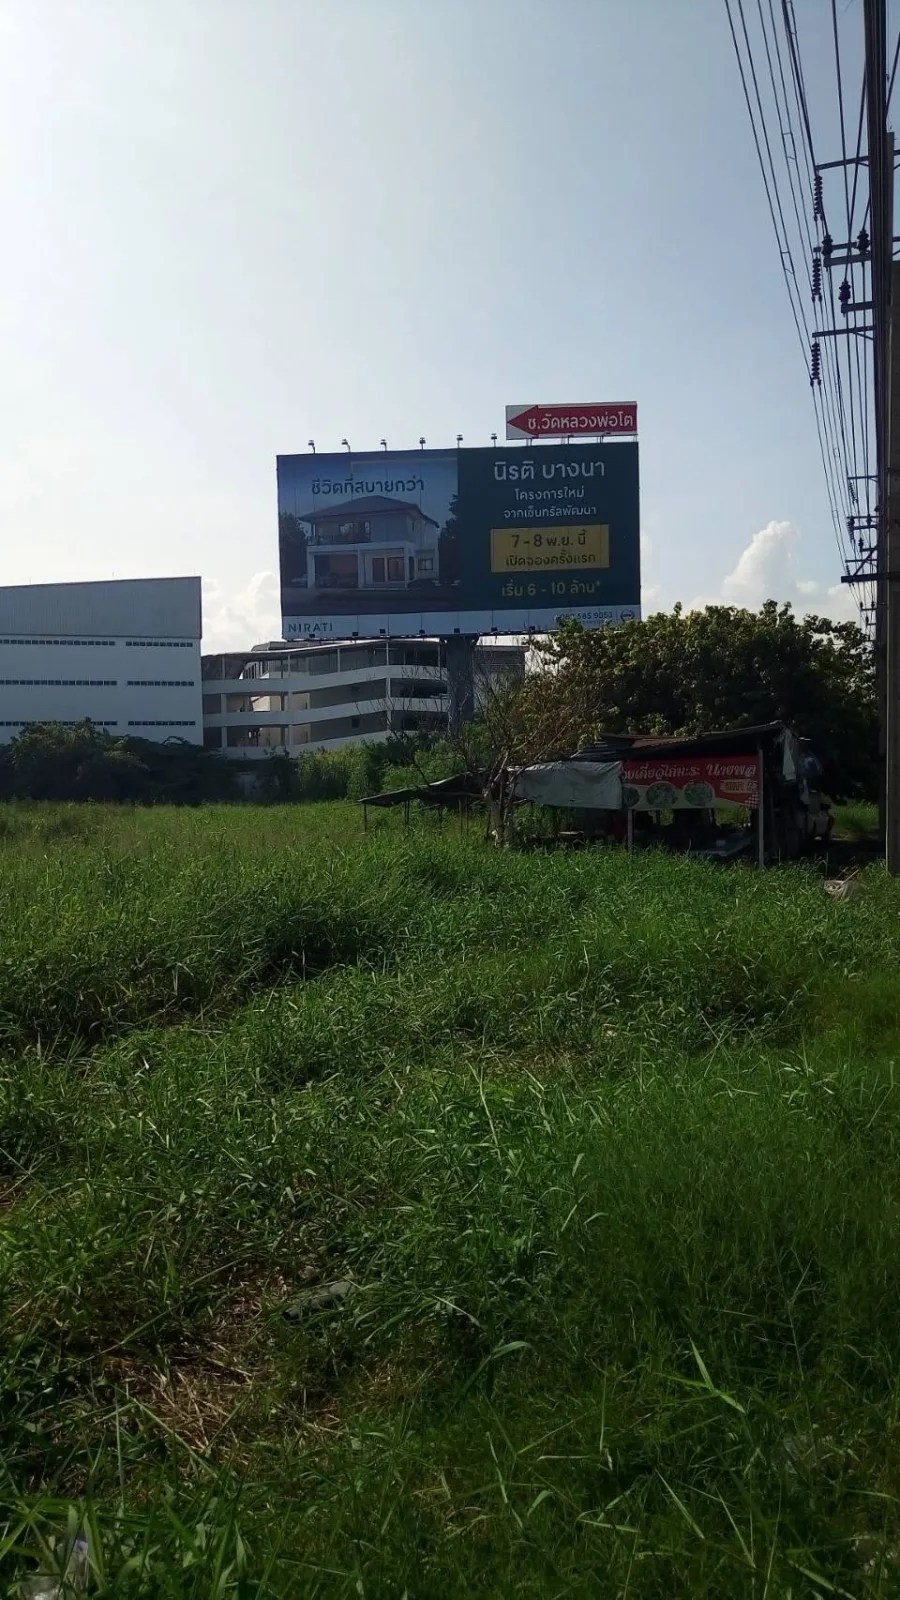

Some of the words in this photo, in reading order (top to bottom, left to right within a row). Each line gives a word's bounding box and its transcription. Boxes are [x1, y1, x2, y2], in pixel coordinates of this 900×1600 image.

[494, 460, 535, 481] นิรติ
[542, 461, 605, 479] บางนา
[312, 474, 424, 495] ชีวิตที่สบายกว่า
[514, 485, 585, 500] โครงการใหม่
[503, 504, 597, 519] จากเซ็นทรัลพัฒนา
[511, 534, 520, 548] 7
[533, 534, 543, 548] 8
[546, 535, 574, 547] พ.ย.
[577, 529, 588, 546] นี้
[505, 549, 596, 567] เปิดจองครั้งแรก
[502, 578, 523, 597] เริ่ม
[527, 582, 537, 596] 6
[552, 581, 566, 595] 10
[288, 623, 333, 633] NIRATI
